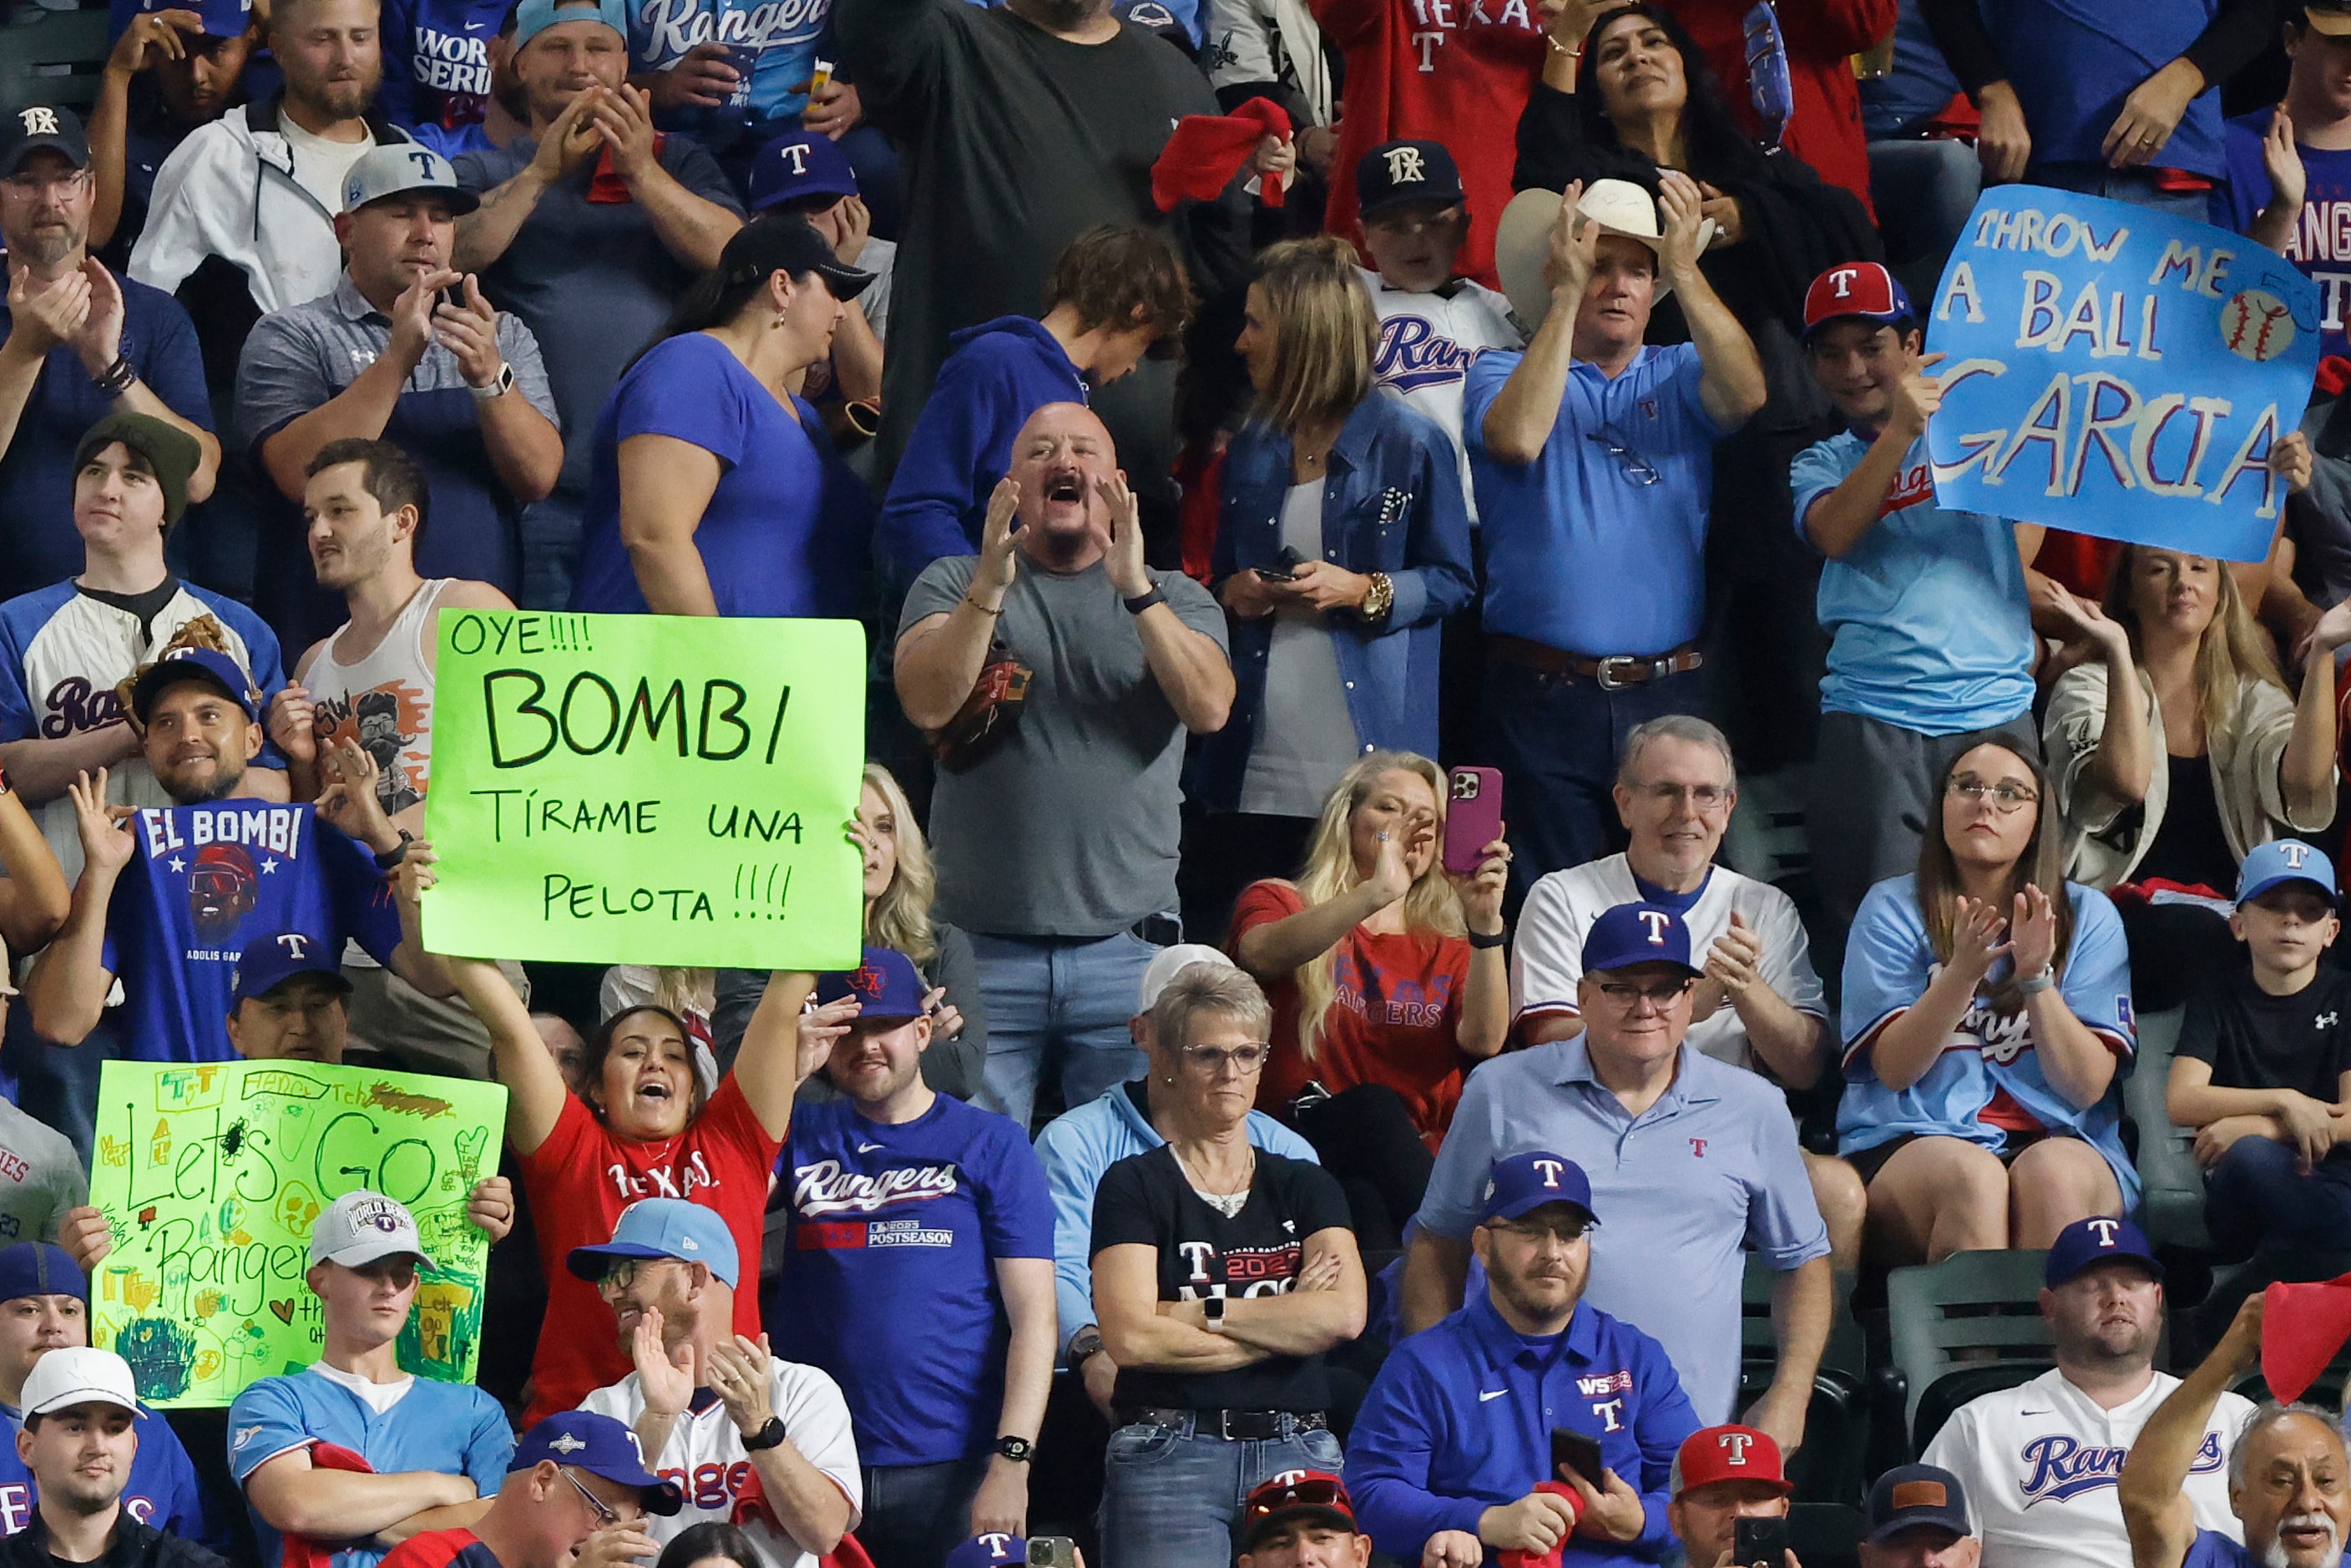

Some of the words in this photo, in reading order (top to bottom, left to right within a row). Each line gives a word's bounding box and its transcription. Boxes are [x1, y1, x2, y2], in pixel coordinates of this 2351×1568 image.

[408, 152, 436, 180] T
[781, 144, 811, 175] T
[1974, 208, 2129, 262] THROW
[2149, 240, 2235, 298] ME
[1828, 270, 1857, 297] T
[1937, 261, 1985, 322] A
[2015, 269, 2162, 361] BALL
[1927, 358, 2280, 519] GARCIA
[451, 614, 593, 655] OYE!!!!
[483, 668, 791, 769] BOMBI
[469, 788, 661, 842] TÍRAME
[708, 803, 804, 845] UNA
[142, 808, 185, 860] EL
[193, 807, 304, 860] BOMBI
[2279, 843, 2310, 869] T
[1638, 910, 1670, 945] T
[187, 950, 220, 961] ADOLIS
[277, 933, 309, 959] T
[1689, 1137, 1708, 1157] T
[794, 1159, 958, 1218] Rangers
[1533, 1160, 1565, 1188] T
[869, 1231, 953, 1246] POSTSEASON
[889, 1222, 919, 1231] 2023
[2088, 1220, 2119, 1247] T
[1179, 1242, 1216, 1282] T
[1593, 1398, 1625, 1432] T
[1718, 1433, 1752, 1465] T
[978, 1533, 1010, 1558] T
